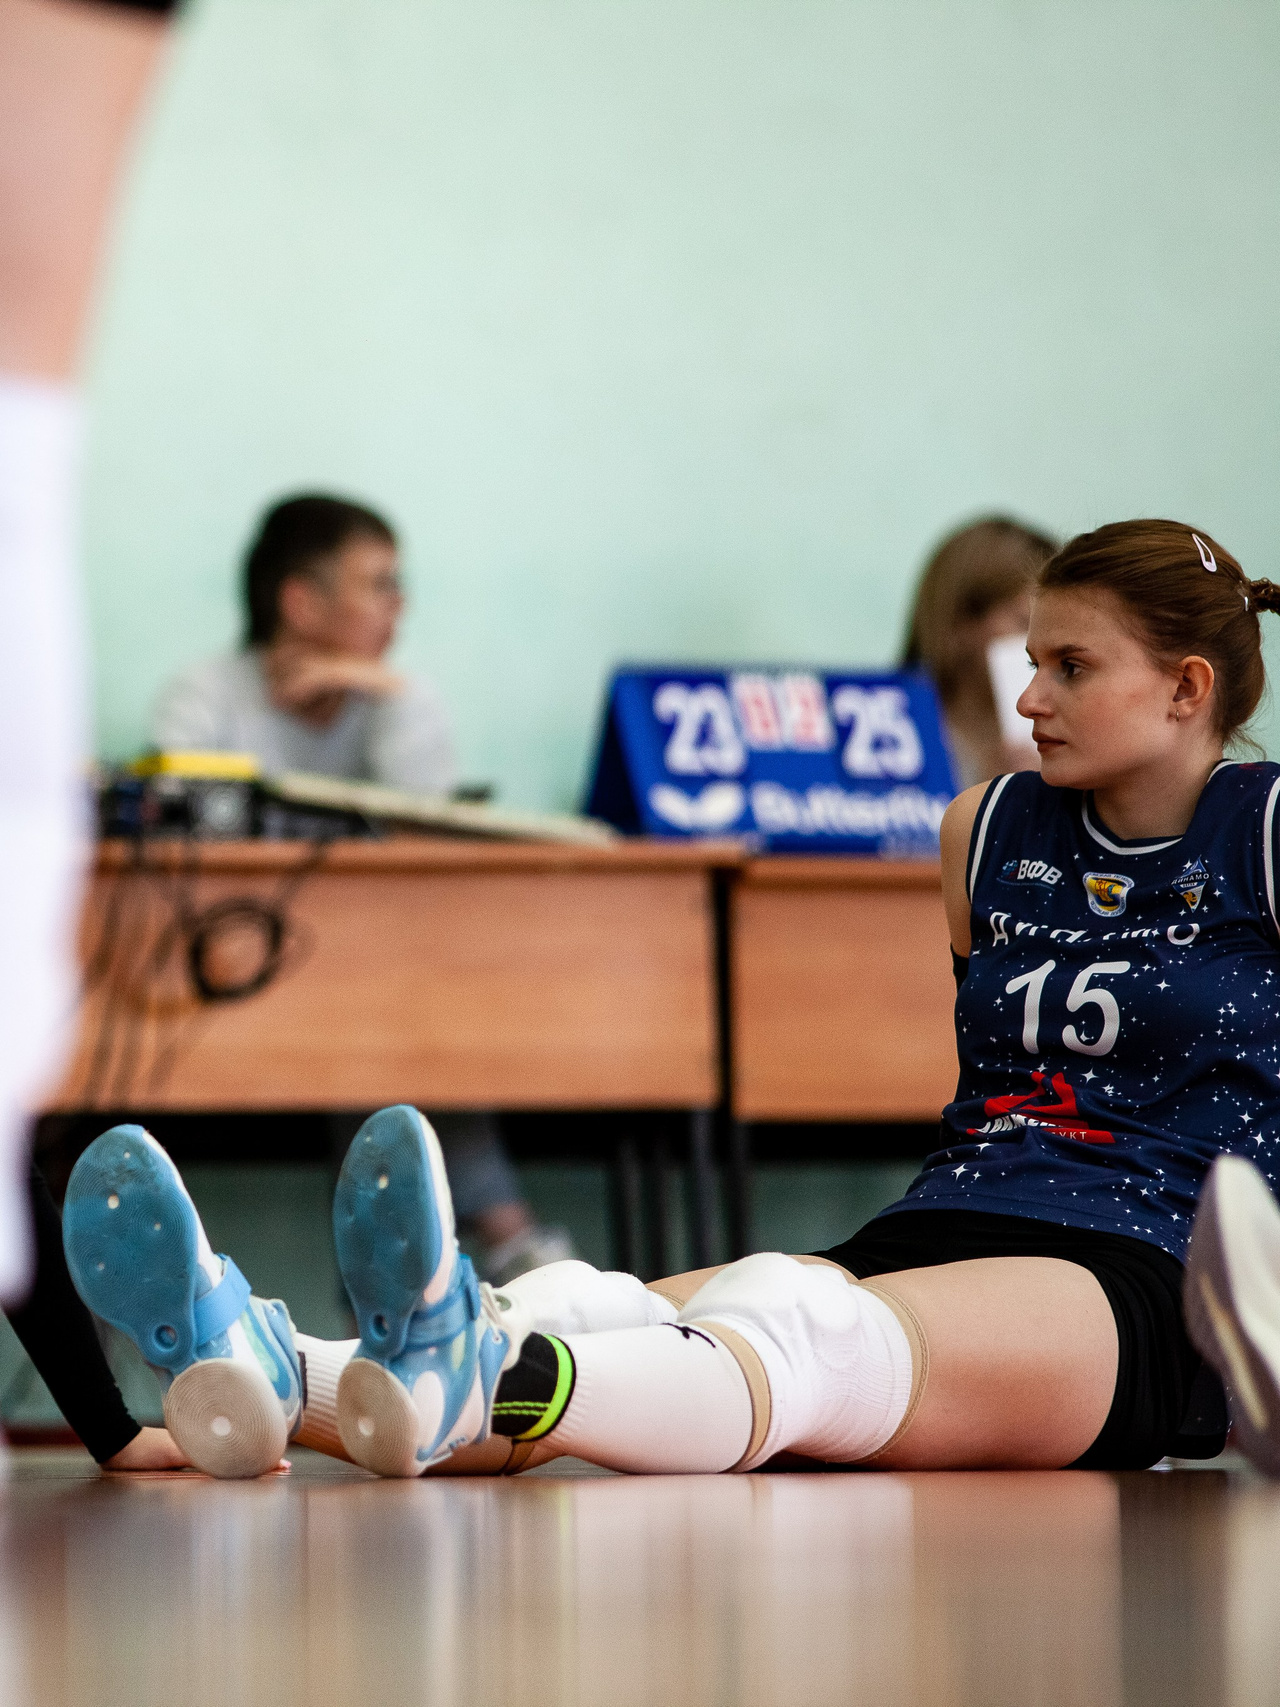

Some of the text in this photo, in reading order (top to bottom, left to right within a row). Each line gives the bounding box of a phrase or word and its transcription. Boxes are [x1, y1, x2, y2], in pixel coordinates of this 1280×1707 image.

[653, 682, 747, 776] 23
[832, 684, 924, 780] 25
[1017, 859, 1063, 884] ВФВ
[1005, 959, 1131, 1057] 15
